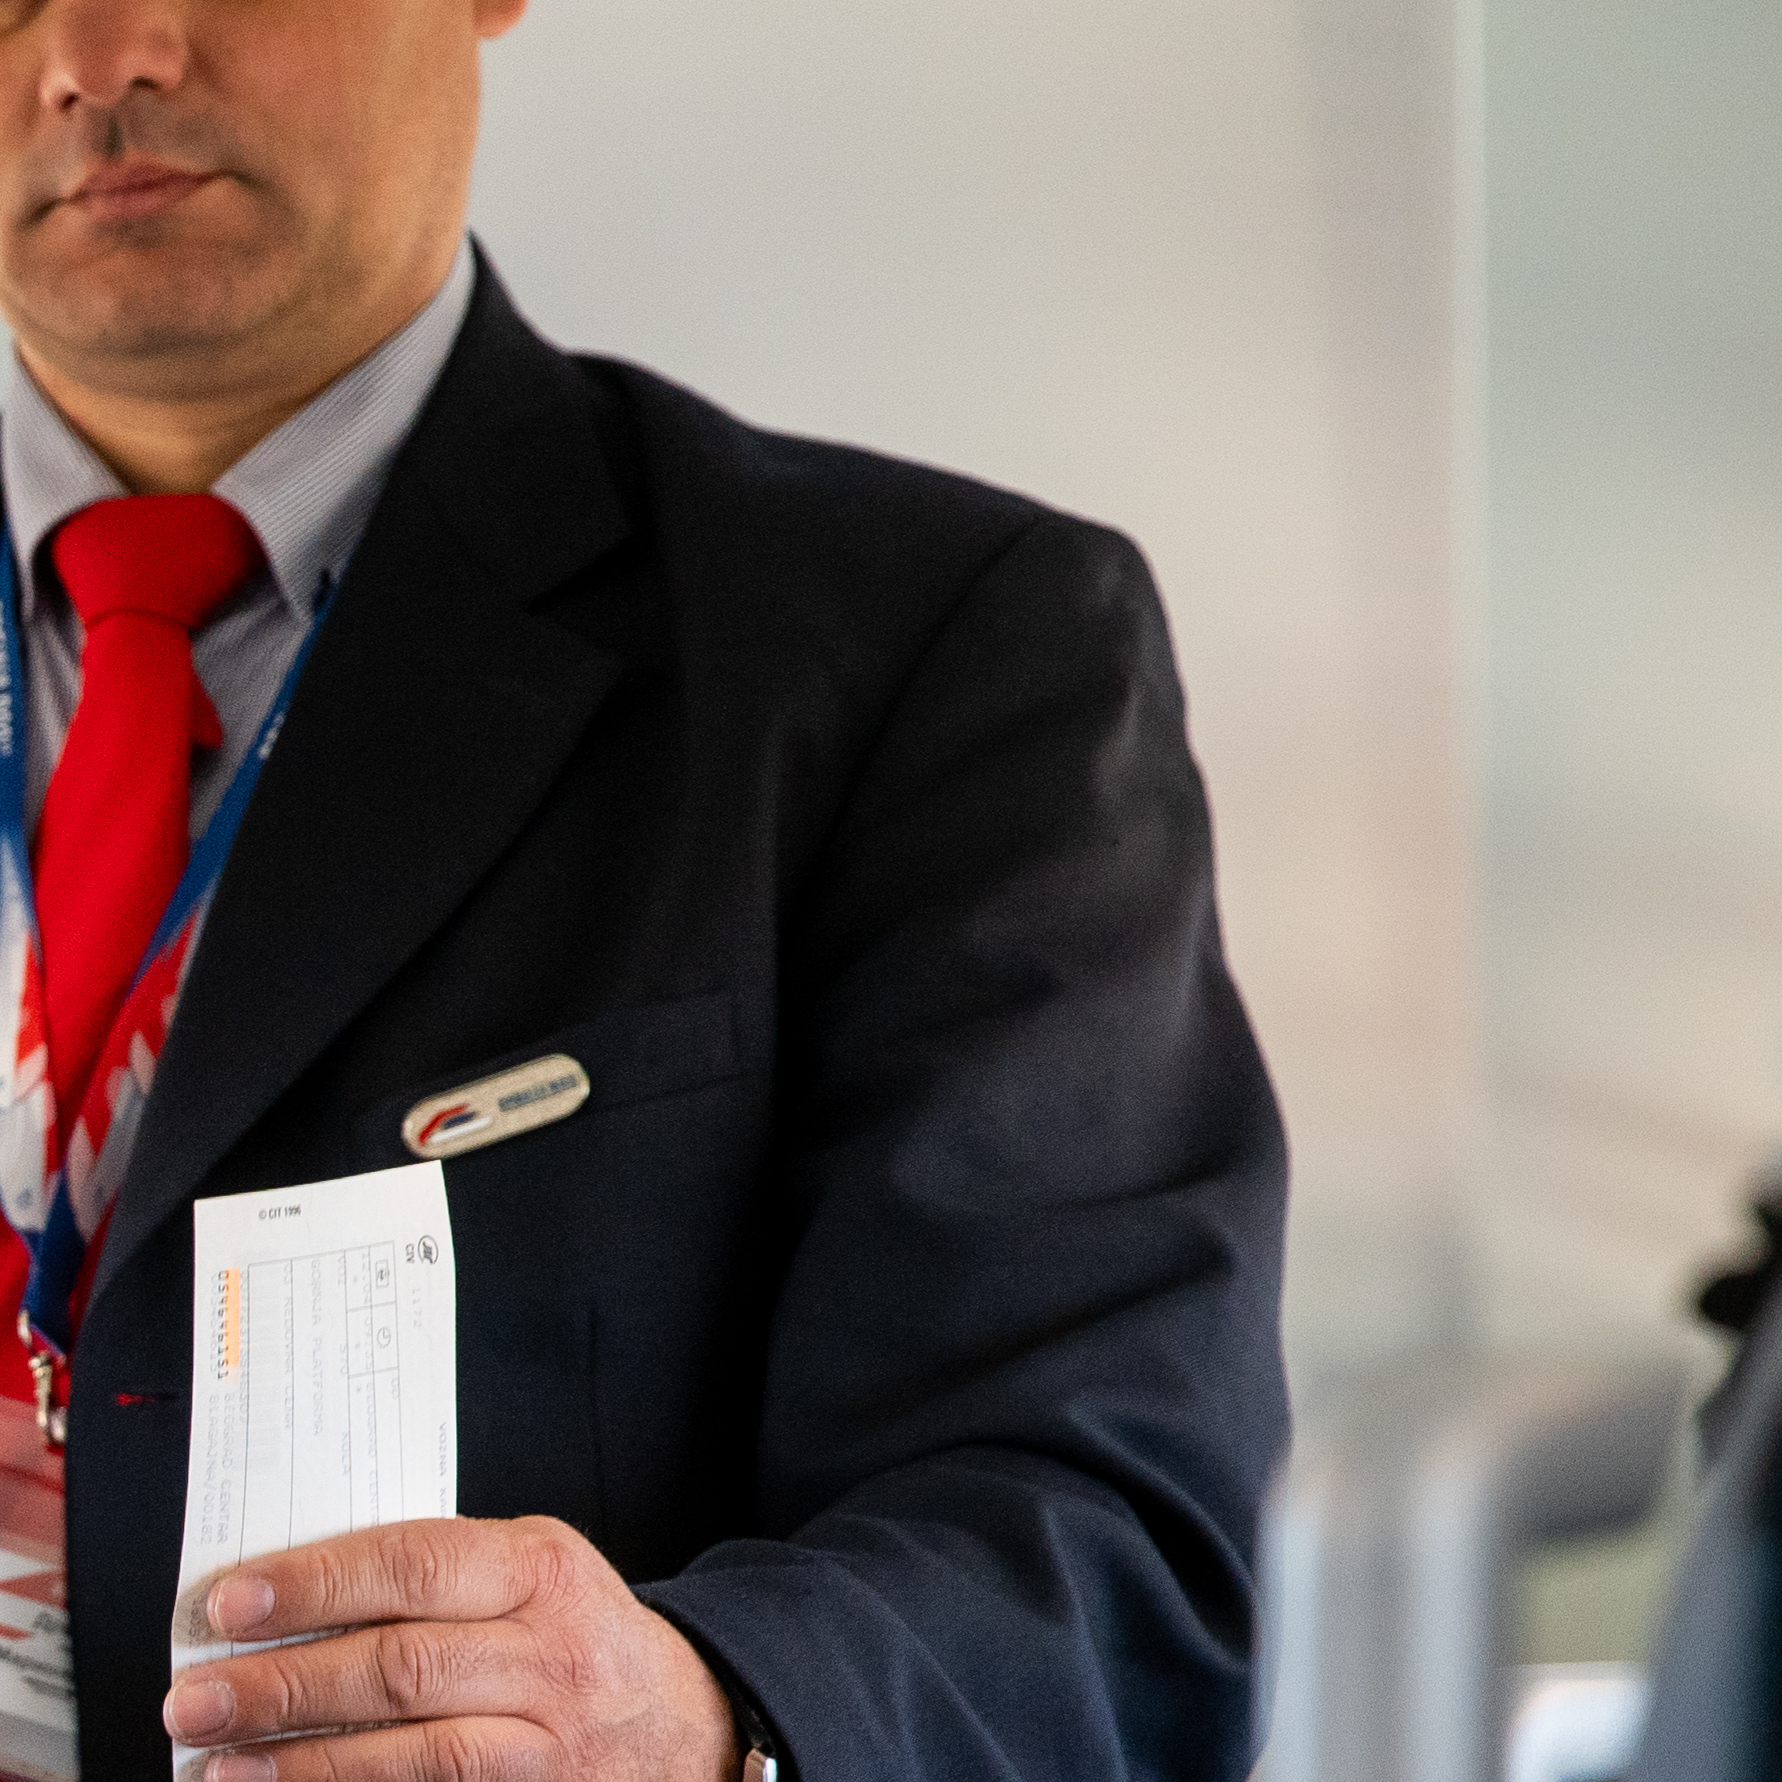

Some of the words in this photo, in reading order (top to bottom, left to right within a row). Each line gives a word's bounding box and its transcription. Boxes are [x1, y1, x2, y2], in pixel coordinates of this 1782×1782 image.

[406, 1244, 416, 1263] CIV
[311, 1259, 323, 1326] GORNJA
[312, 1337, 324, 1435] PLATFORMA
[222, 1393, 235, 1470] BEOGRAD
[217, 1481, 231, 1544] CENTAR
